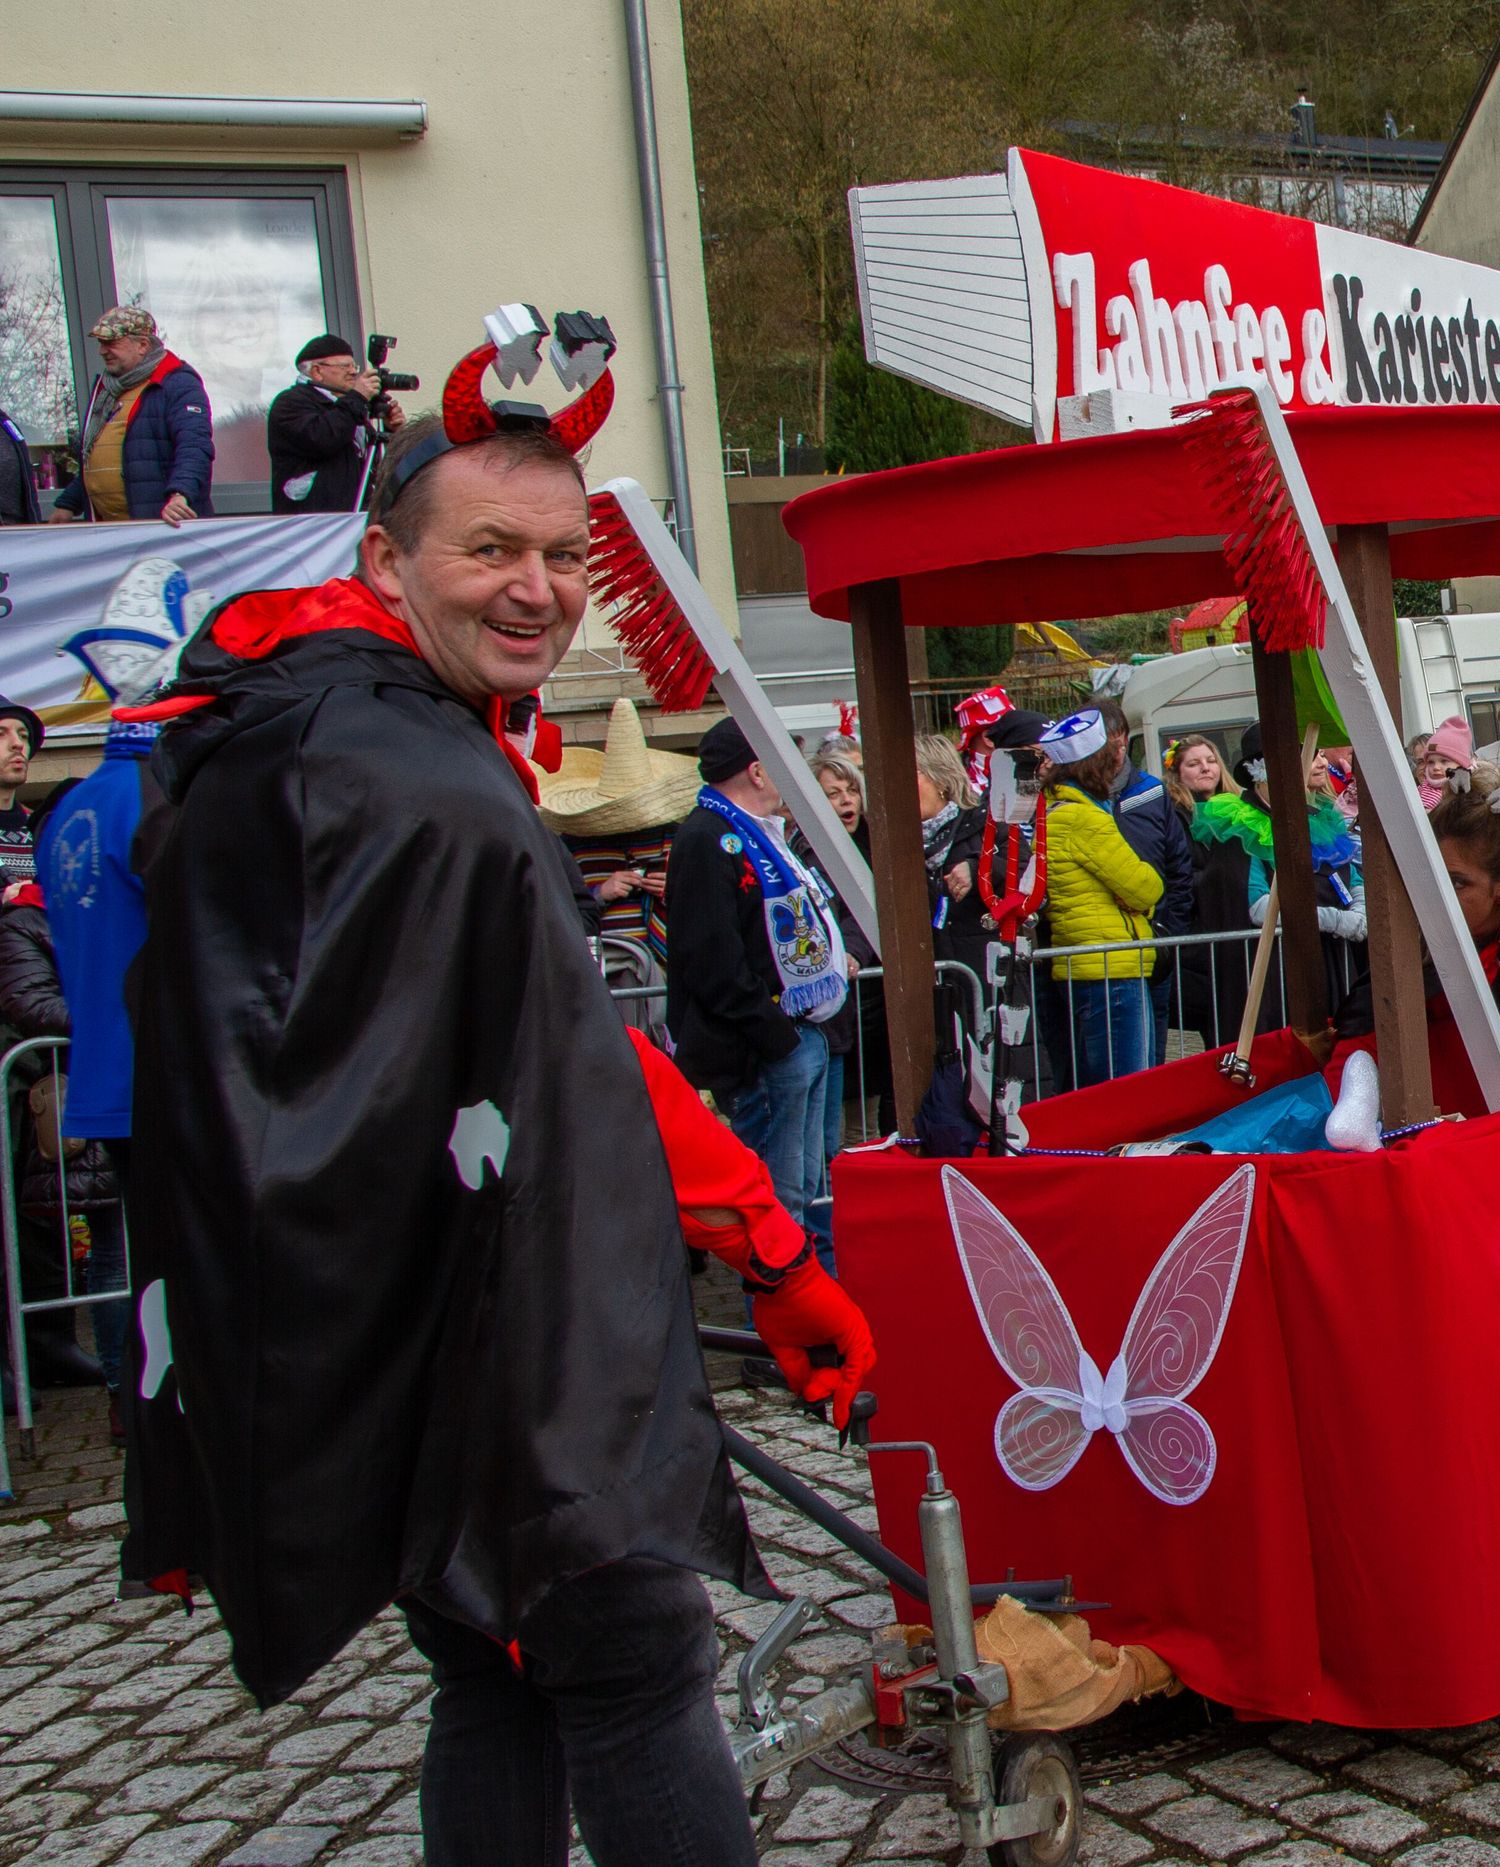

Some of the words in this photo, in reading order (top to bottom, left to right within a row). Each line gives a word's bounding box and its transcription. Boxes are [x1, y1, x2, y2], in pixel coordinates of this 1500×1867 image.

[1053, 251, 1294, 405] Zahnfee
[1300, 308, 1336, 406] &
[759, 858, 783, 884] KV
